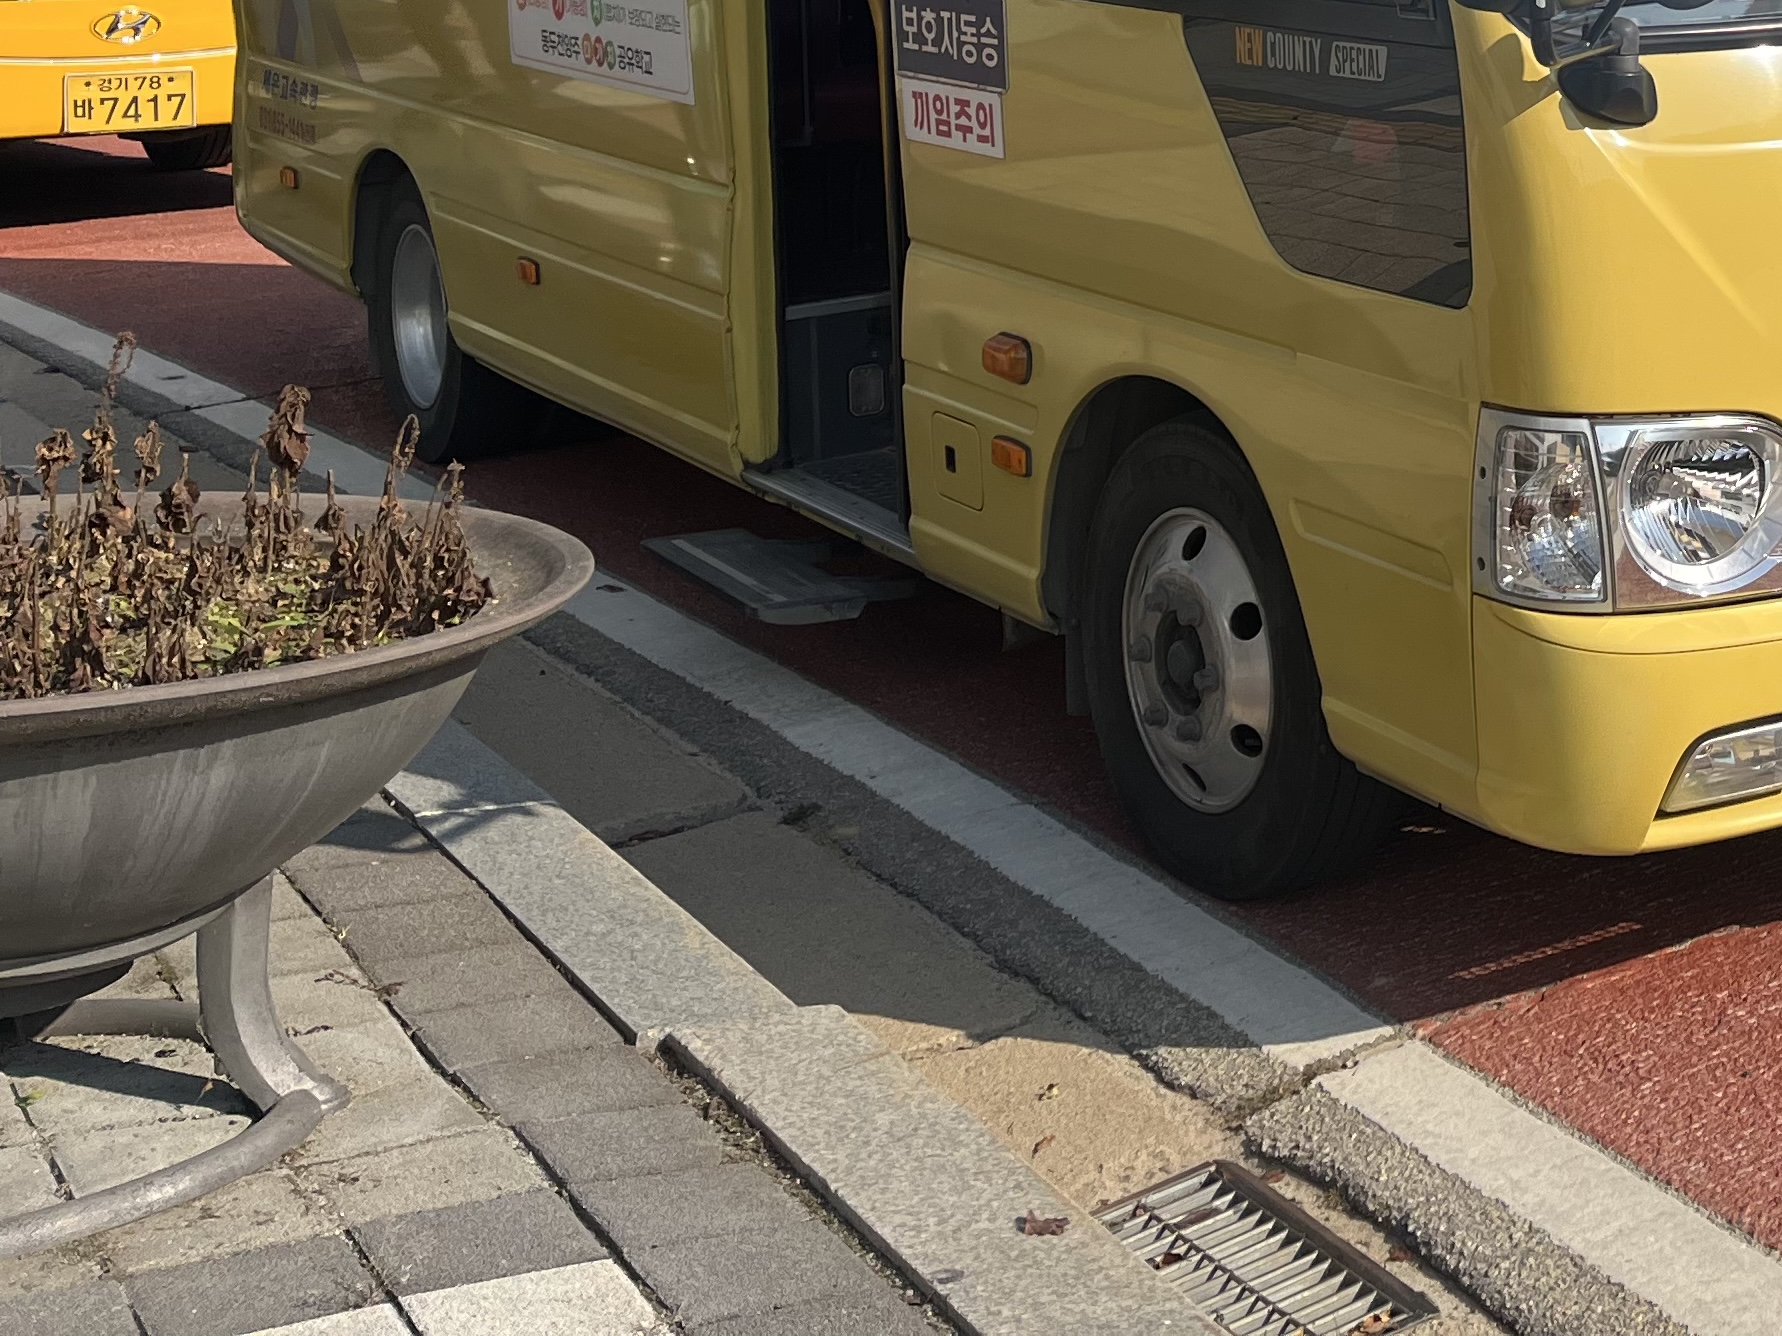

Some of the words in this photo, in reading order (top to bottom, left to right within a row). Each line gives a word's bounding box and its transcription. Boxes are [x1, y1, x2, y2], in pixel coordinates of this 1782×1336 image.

[902, 4, 999, 68] 보호자동승
[1235, 26, 1263, 66] NEW
[1266, 31, 1322, 74] COUNTY
[1334, 44, 1382, 79] SPECIAL
[911, 90, 996, 148] 끼임주의
